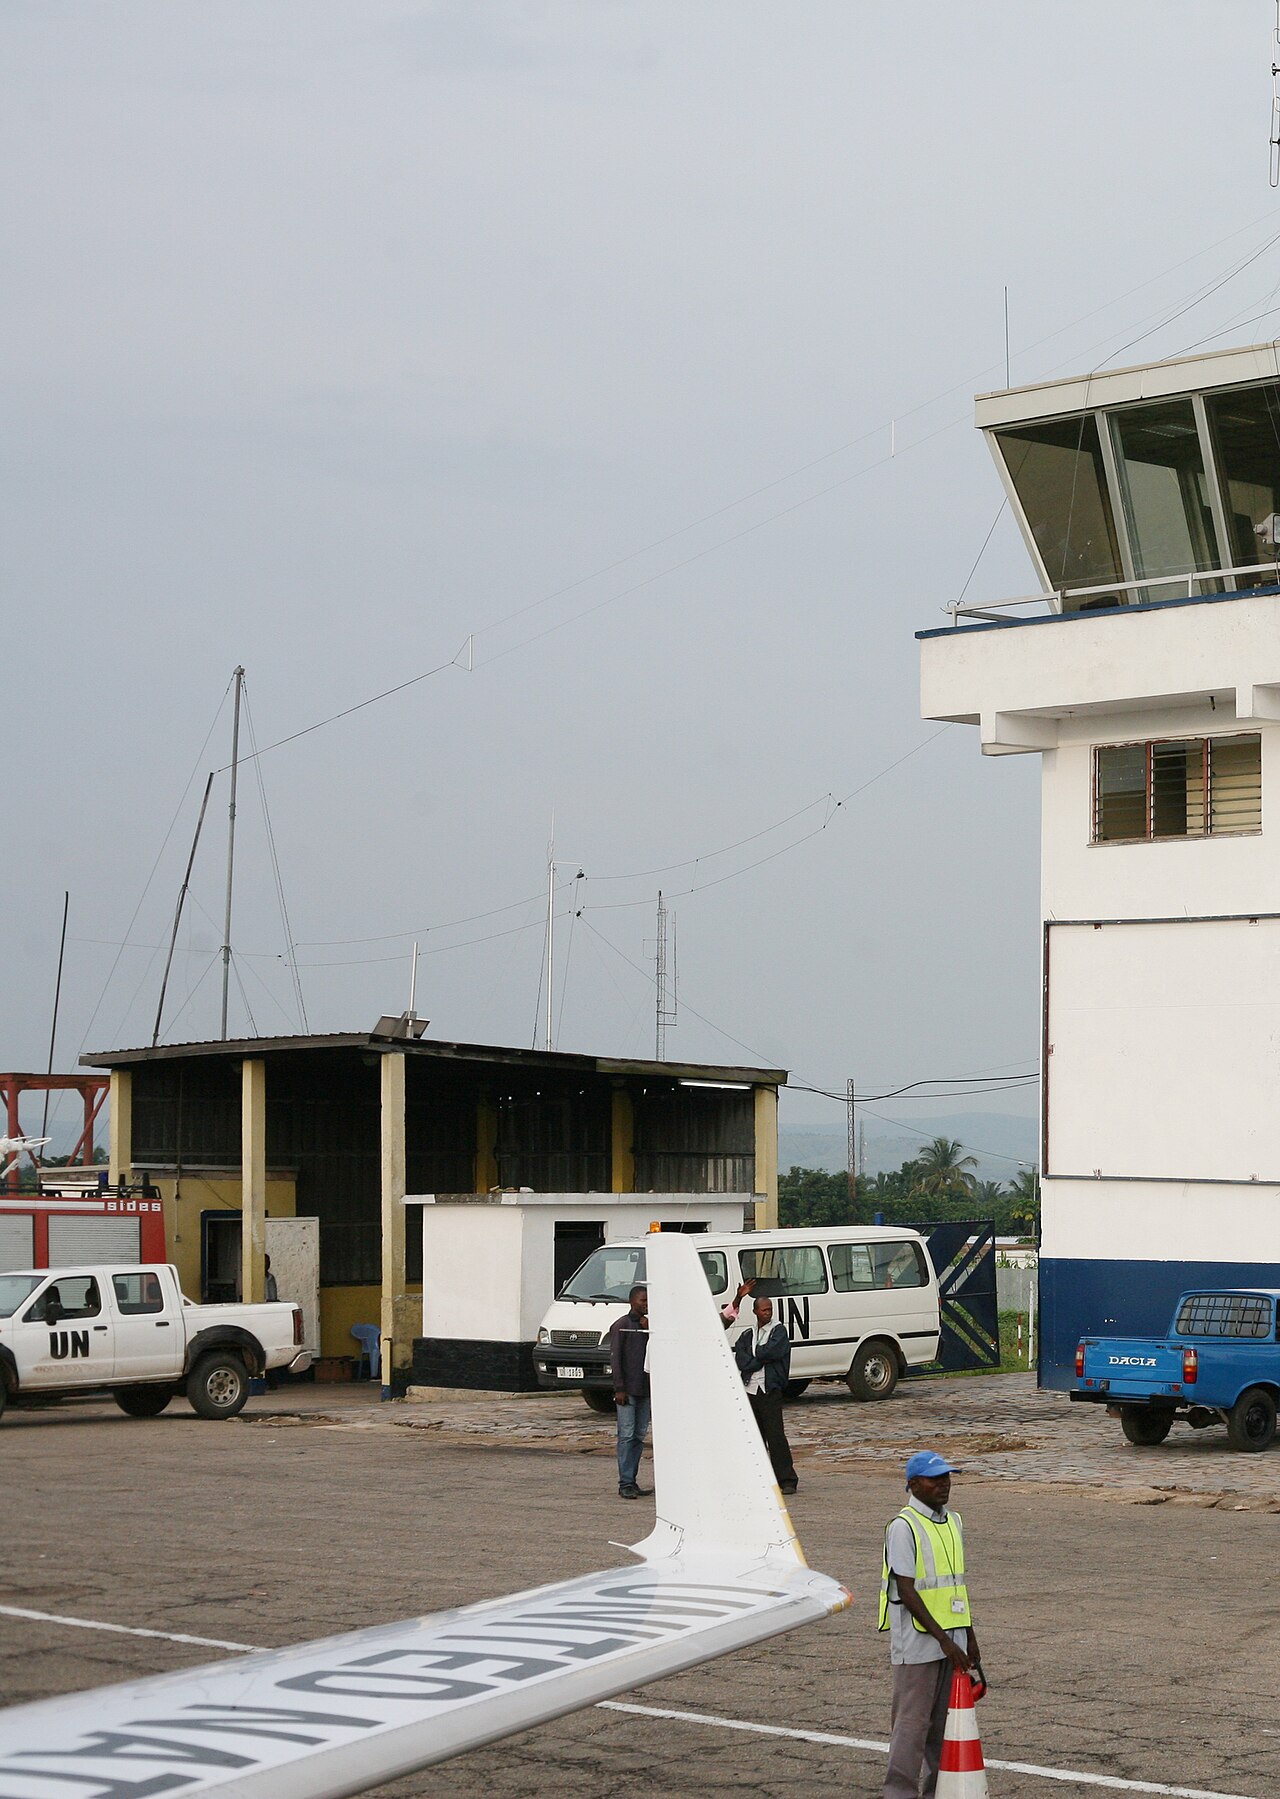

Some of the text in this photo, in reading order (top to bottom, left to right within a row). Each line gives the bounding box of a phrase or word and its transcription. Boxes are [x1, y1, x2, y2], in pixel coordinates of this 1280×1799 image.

[107, 1200, 161, 1212] sides
[49, 1330, 89, 1359] UN
[1109, 1356, 1157, 1366] DACIA
[0, 1583, 790, 1799] UNITED NAT
